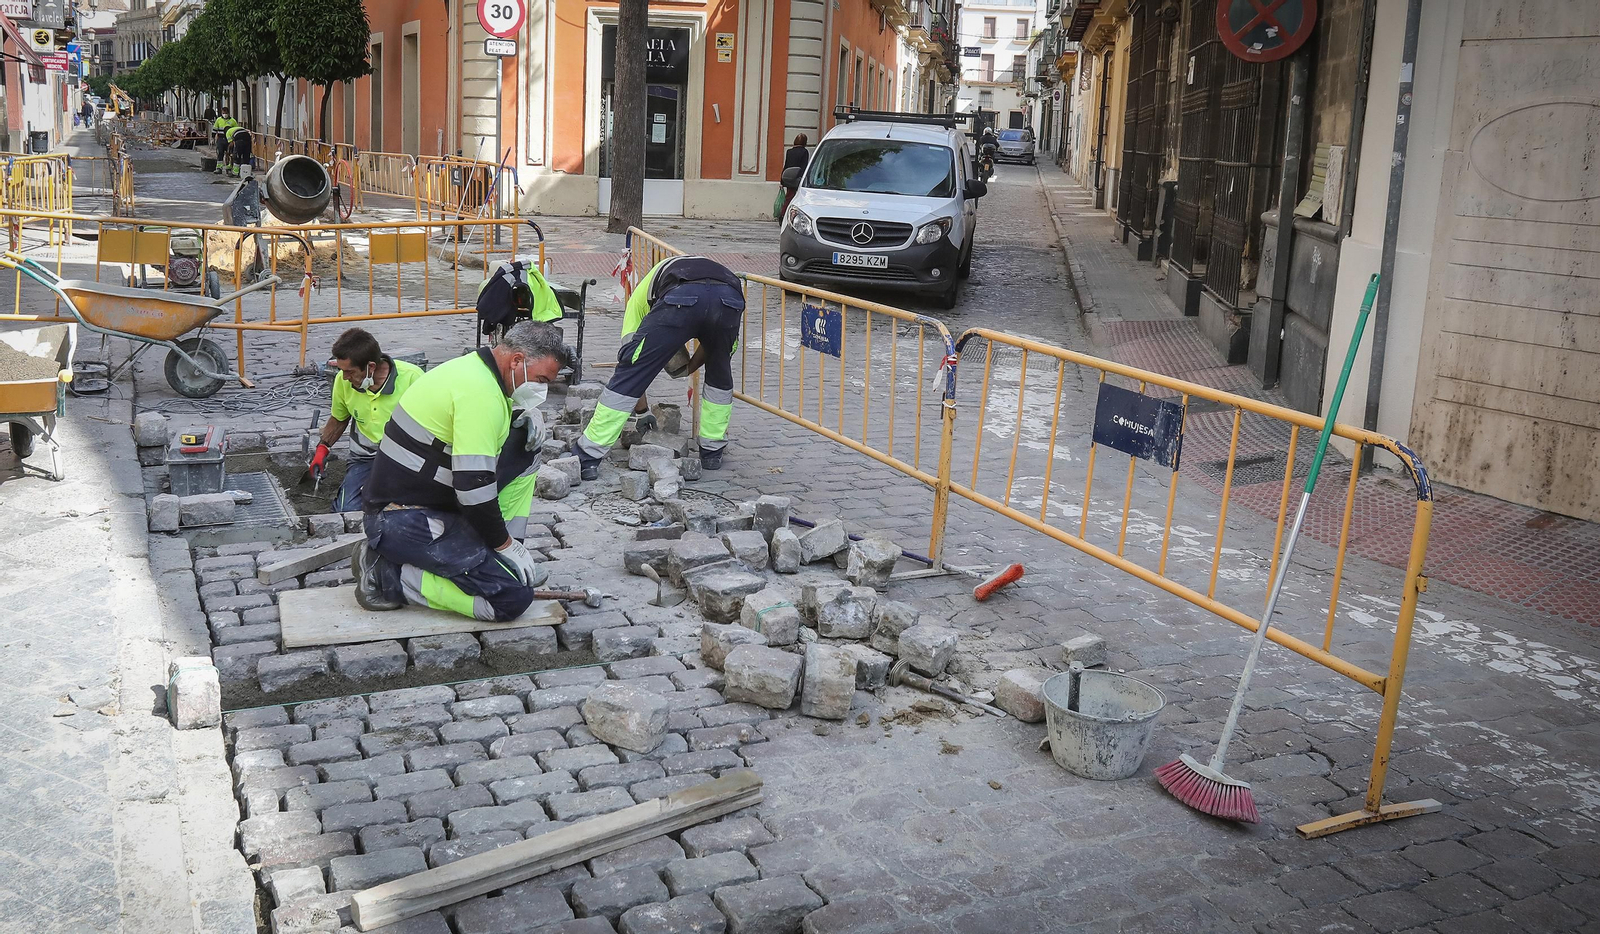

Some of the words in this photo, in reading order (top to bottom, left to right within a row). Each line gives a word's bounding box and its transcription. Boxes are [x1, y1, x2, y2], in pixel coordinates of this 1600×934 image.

[33, 10, 63, 23] Claveles
[491, 4, 513, 20] 30
[839, 254, 864, 265] 8295
[866, 256, 886, 267] KZM
[1112, 414, 1154, 437] COMUJESA
